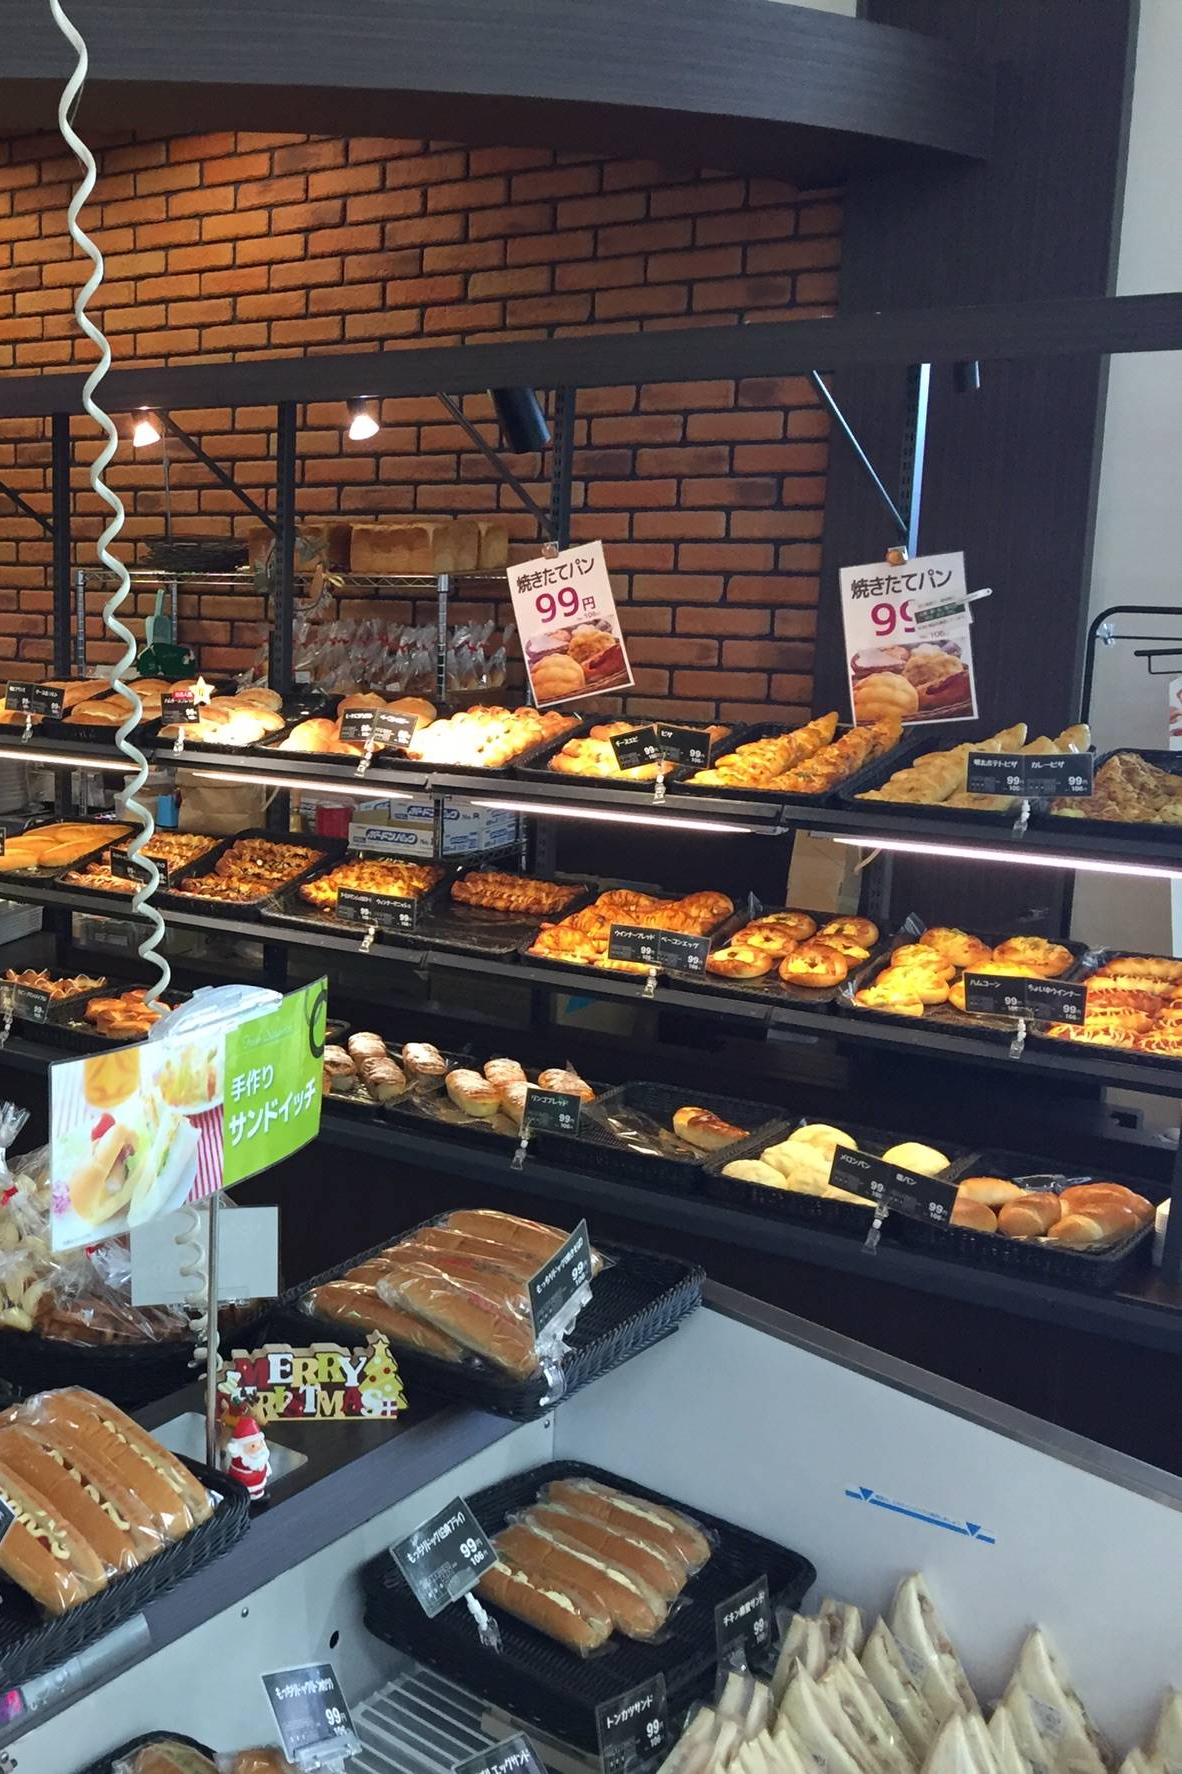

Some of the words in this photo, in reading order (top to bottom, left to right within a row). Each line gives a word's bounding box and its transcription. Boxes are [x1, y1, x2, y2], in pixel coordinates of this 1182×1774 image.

[516, 557, 595, 594] 焼きたてパン
[850, 569, 953, 600] 焼きたてパン
[534, 586, 597, 624] 99円
[1030, 760, 1066, 770] カレーピザ
[230, 1063, 274, 1102] 手作り
[228, 1076, 317, 1147] サンドイッチ
[840, 1153, 872, 1170] メロンパン
[234, 1353, 367, 1387] MERRY
[606, 1694, 653, 1729] トンカツサンド
